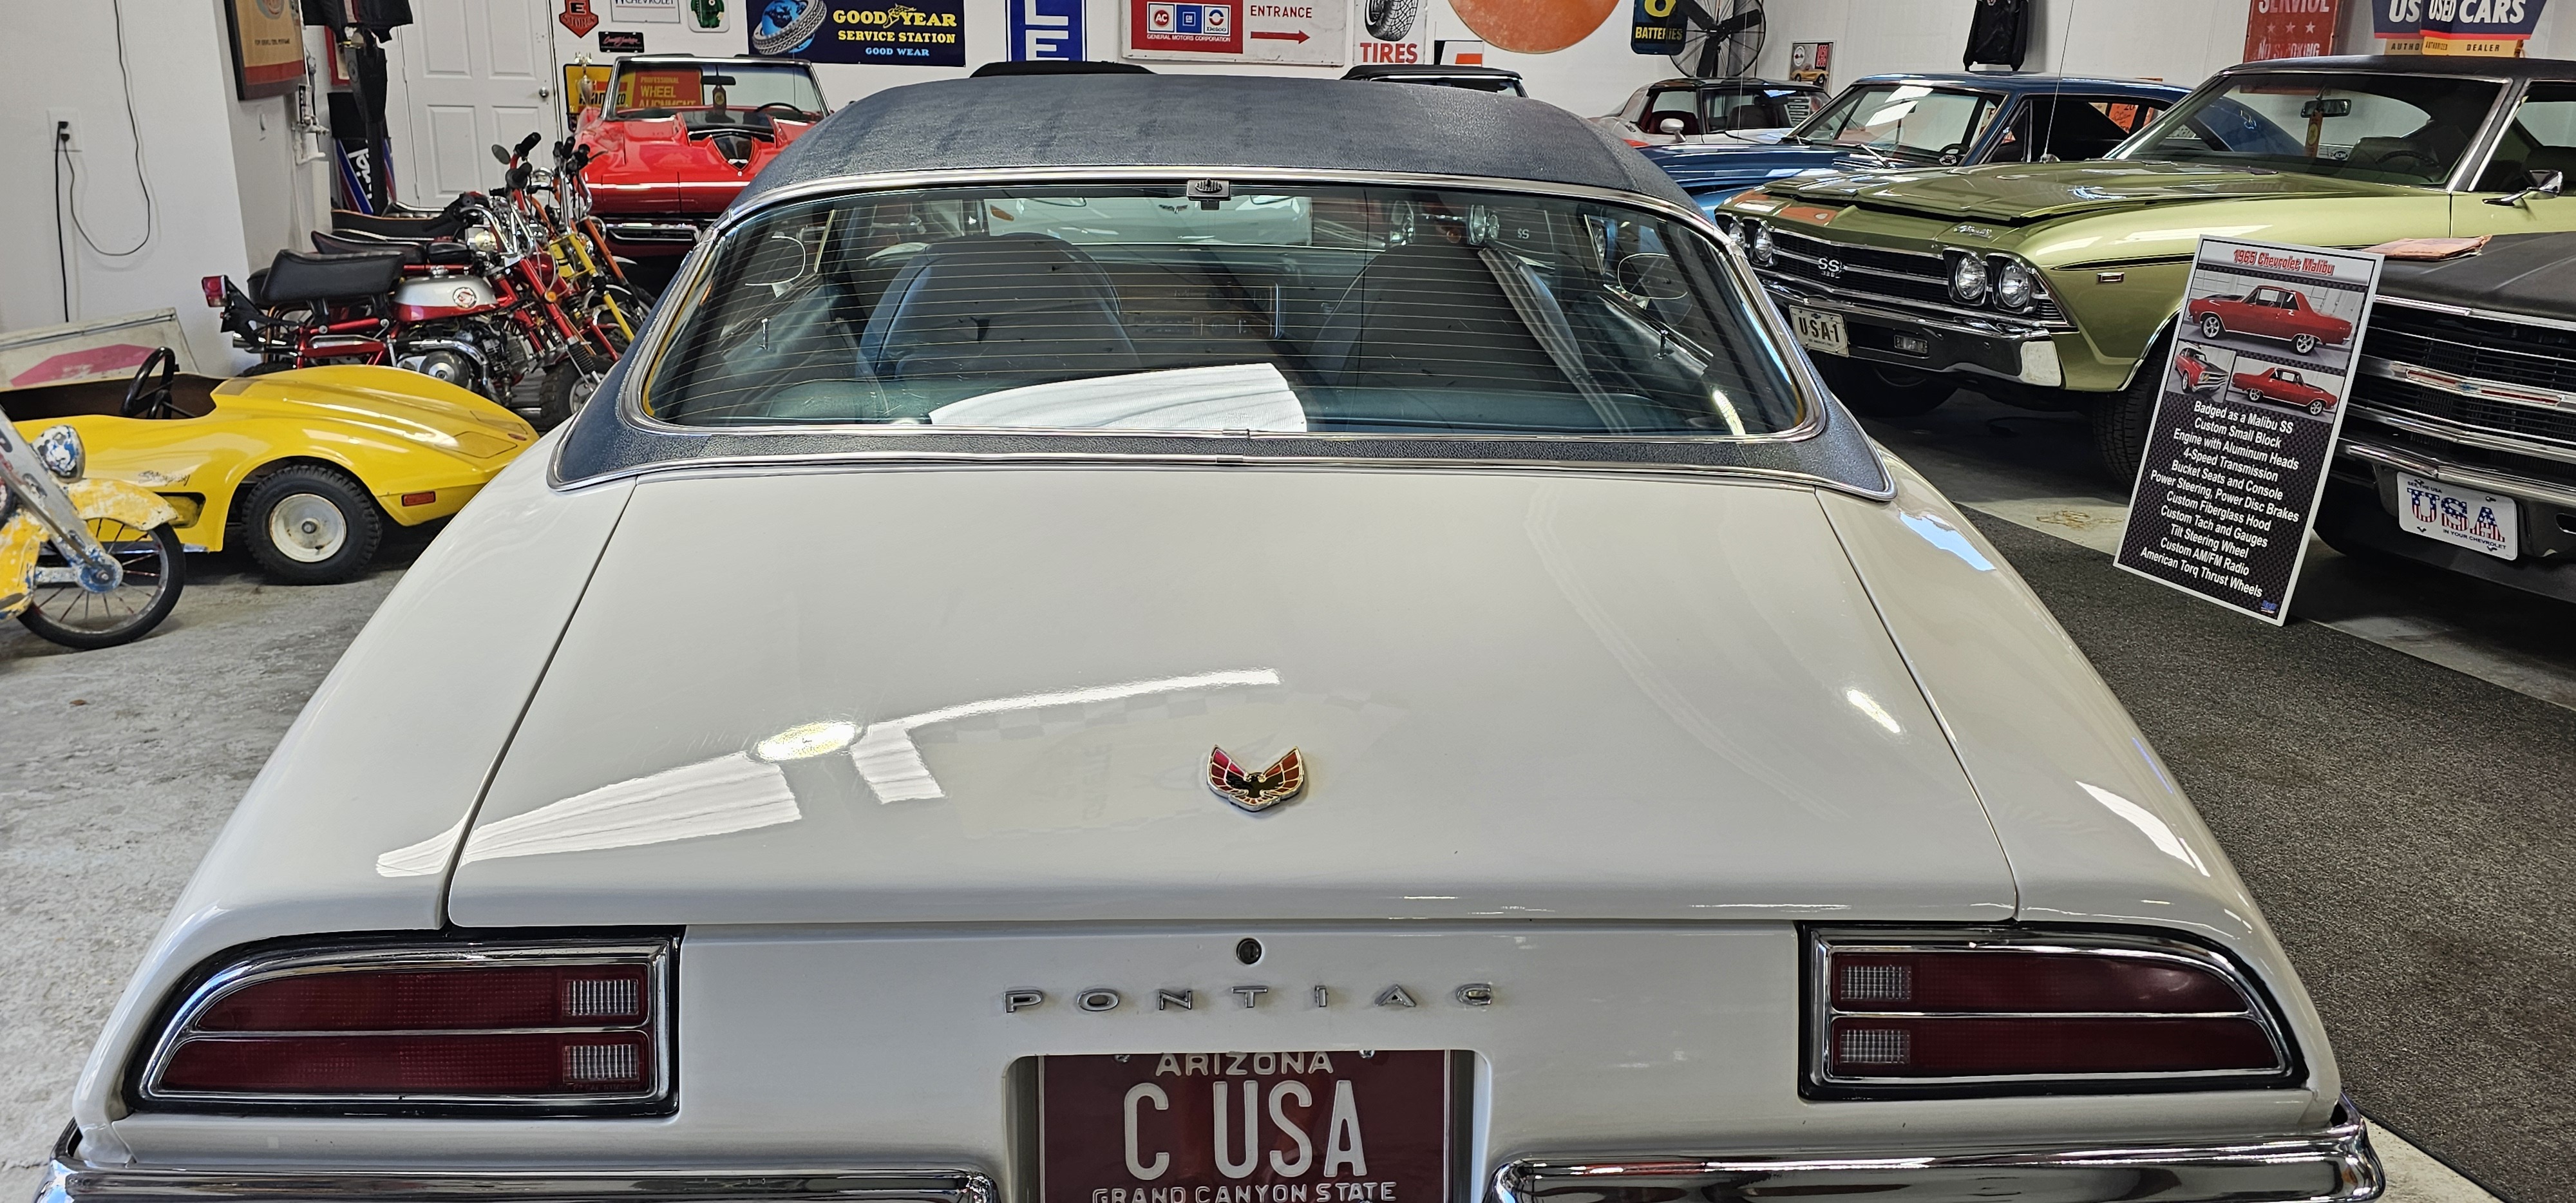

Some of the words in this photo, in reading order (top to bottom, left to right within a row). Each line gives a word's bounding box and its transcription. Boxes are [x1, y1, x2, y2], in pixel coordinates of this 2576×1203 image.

[1155, 14, 1168, 23] AC
[1250, 5, 1312, 19] ENTRANCE
[2429, 0, 2456, 22] USED
[2459, 0, 2526, 23] CARS
[838, 30, 895, 42] SERVICE
[898, 32, 956, 43] STATION
[2258, 43, 2271, 59] NO
[2425, 41, 2448, 50] AUTHORIZED
[865, 47, 894, 55] GOOD
[896, 48, 930, 57] WEAR
[1359, 43, 1418, 64] TIRES
[640, 85, 676, 98] WHEEL
[1818, 258, 1840, 272] SS
[2234, 249, 2257, 265] 1965
[2258, 252, 2300, 272] Chevrolet
[2302, 258, 2335, 276] Malibu
[2194, 400, 2226, 418] Badged
[2228, 411, 2238, 422] as
[2240, 413, 2247, 424] a
[2248, 413, 2278, 430] Malibu
[2279, 420, 2294, 434] SS
[2195, 417, 2227, 436] Custom
[2229, 425, 2254, 442] Small
[2255, 431, 2282, 449] Block
[2174, 428, 2202, 445] Engine
[2204, 435, 2222, 448] with
[2222, 439, 2268, 461] Aluminum
[2269, 453, 2300, 471] Heads
[2183, 448, 2217, 466] 4-Speed
[2219, 457, 2278, 482] Transmission
[2172, 459, 2200, 477] Bucket
[2201, 468, 2226, 484] Seats
[2227, 475, 2244, 489] and
[2245, 480, 2284, 501] Console
[2150, 469, 2175, 486] Power
[2177, 477, 2213, 499] Steering,
[2215, 488, 2242, 506] Power
[2244, 497, 2265, 513] Disc
[2266, 503, 2300, 522] Brakes
[2166, 490, 2197, 509] Custom
[2199, 500, 2245, 523] Fiberglass
[2246, 514, 2271, 532] Hood
[2407, 488, 2505, 542] USA
[2161, 505, 2191, 524] Custom
[2195, 515, 2213, 530] Tach
[2215, 521, 2232, 536] and
[2234, 527, 2268, 547] Gauges
[2451, 529, 2468, 539] YOUR
[2469, 536, 2506, 549] CHEVROLET
[2170, 524, 2183, 537] Tilt
[2184, 527, 2219, 548] Steering
[2221, 540, 2249, 559] Wheel
[2161, 537, 2191, 556] Custom
[2192, 547, 2223, 567] AM/FM
[2224, 558, 2250, 576] Radio
[2140, 546, 2179, 568] American
[2181, 559, 2199, 577] Torq
[2201, 565, 2229, 585] Thrust
[2230, 576, 2263, 598] Wheels
[1004, 981, 1493, 1014] PONTIAC
[1155, 1050, 1333, 1077] ARIZONA
[1123, 1082, 1170, 1181] C
[1213, 1079, 1368, 1179] USA
[1092, 1188, 1184, 1203] GRAND
[1195, 1184, 1307, 1203] CANYON
[1317, 1181, 1396, 1202] STATE
